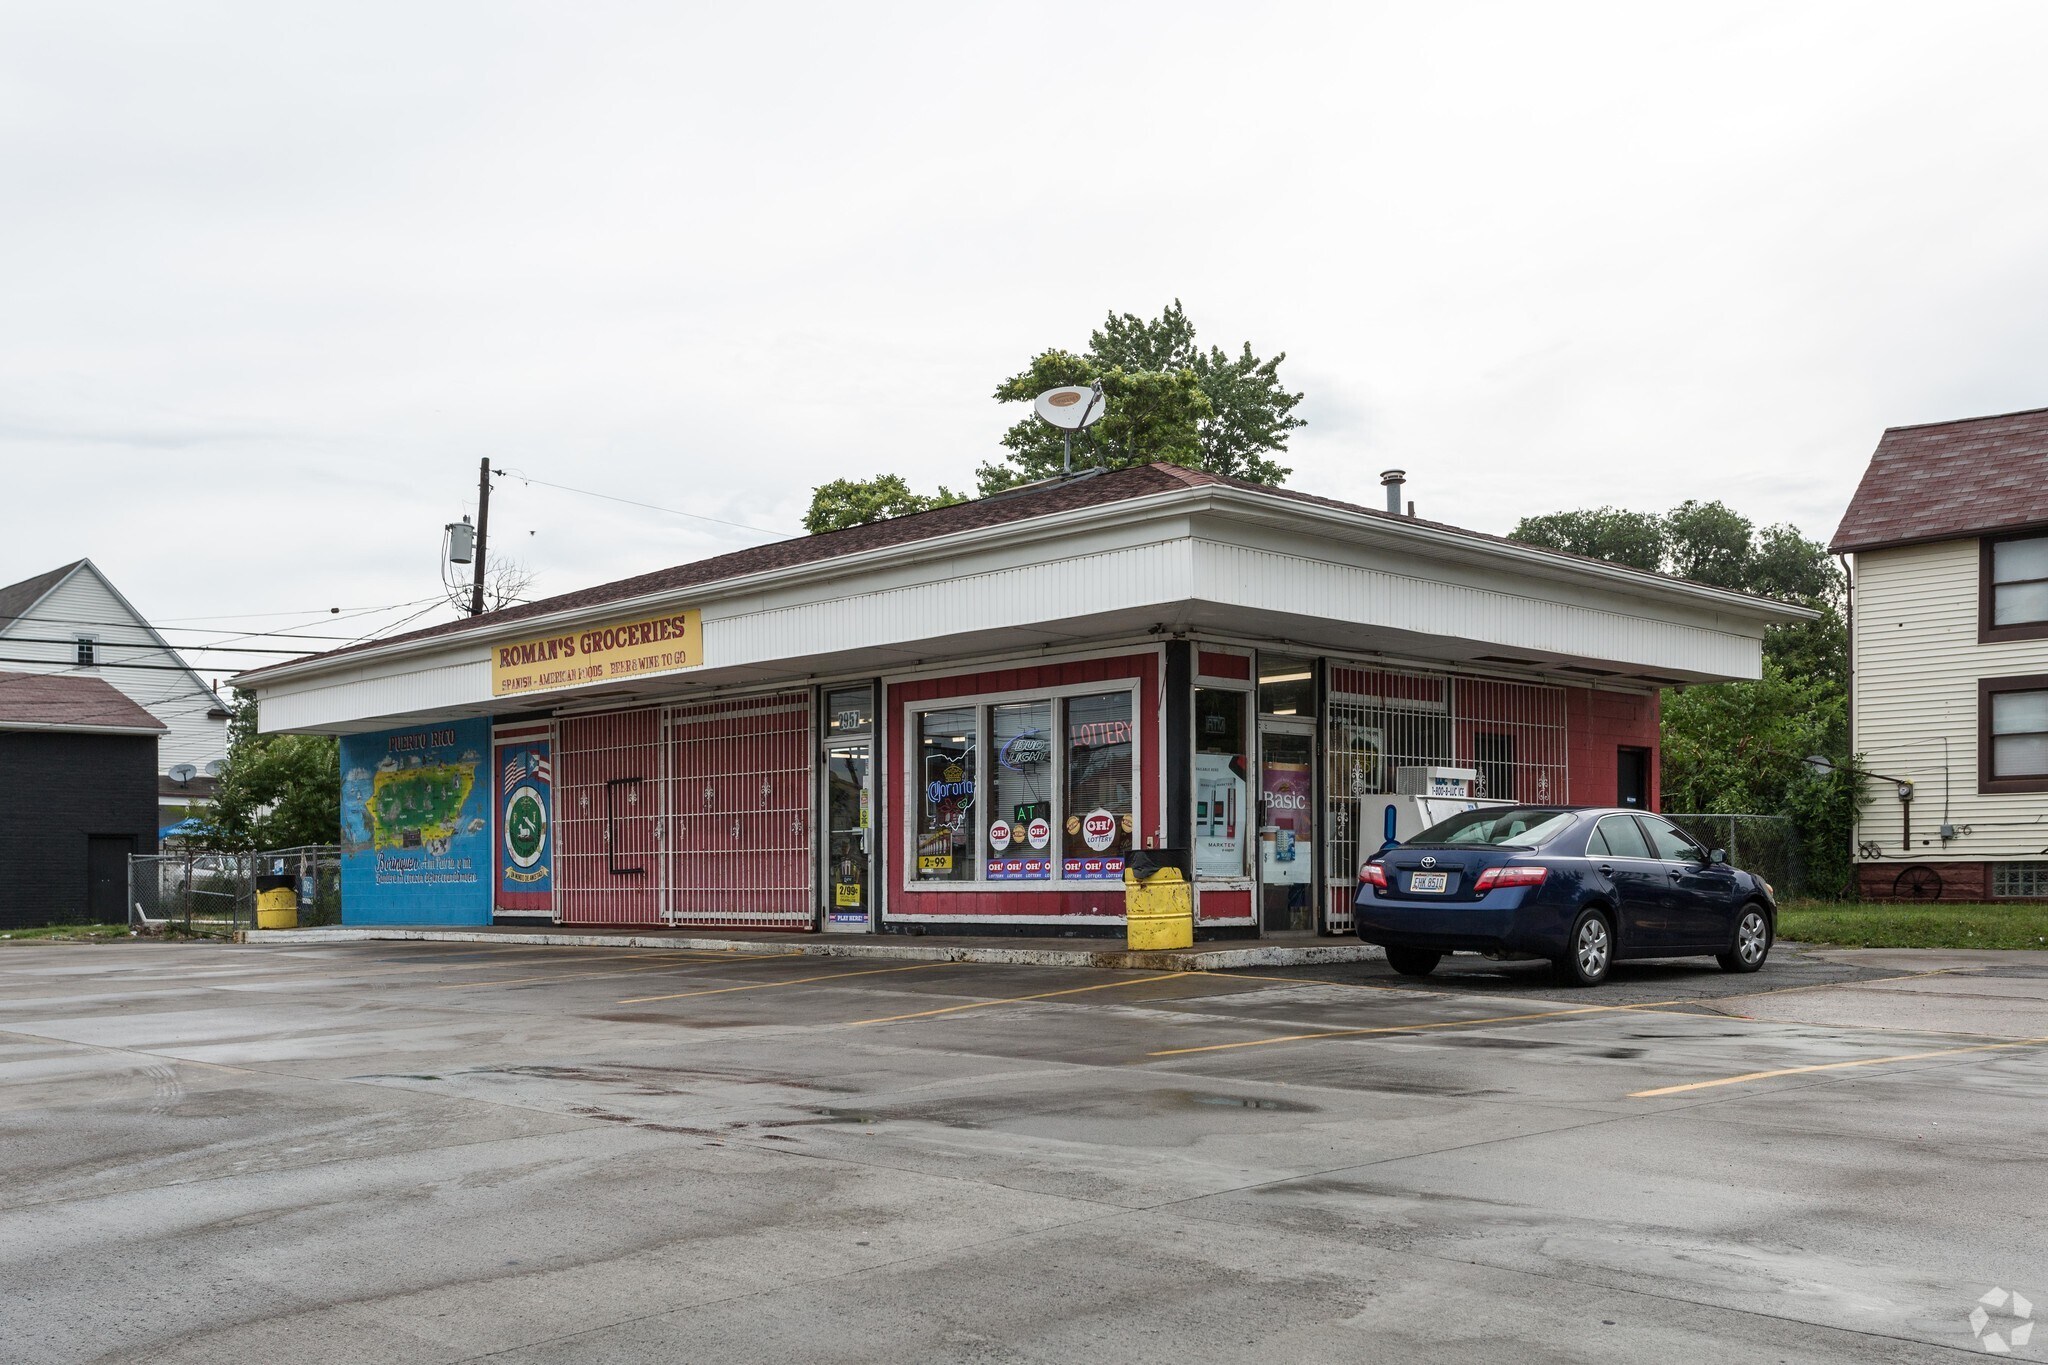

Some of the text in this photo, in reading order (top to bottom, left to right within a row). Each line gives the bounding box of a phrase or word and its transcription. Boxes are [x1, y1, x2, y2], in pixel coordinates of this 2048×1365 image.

[499, 615, 685, 668] ROMAN'S GROCERIES
[662, 653, 673, 666] TO
[674, 651, 686, 664] GO
[502, 675, 532, 691] SPANISH
[539, 669, 577, 686] AMERICAN
[838, 711, 860, 729] 2957
[1071, 720, 1132, 746] LOTTERY
[388, 733, 427, 753] PUERTO
[1014, 739, 1046, 751] BUD
[927, 780, 974, 803] Corona
[1264, 791, 1306, 810] Basic
[1085, 818, 1111, 831] OH!
[992, 829, 1007, 837] OH!
[1030, 827, 1046, 835] OH!
[988, 862, 1004, 870] OH!
[1006, 862, 1022, 870] OH!
[1025, 861, 1041, 870] OH!
[1064, 861, 1082, 870] OH!
[1085, 861, 1102, 870] OH!
[1105, 861, 1123, 870] OH!
